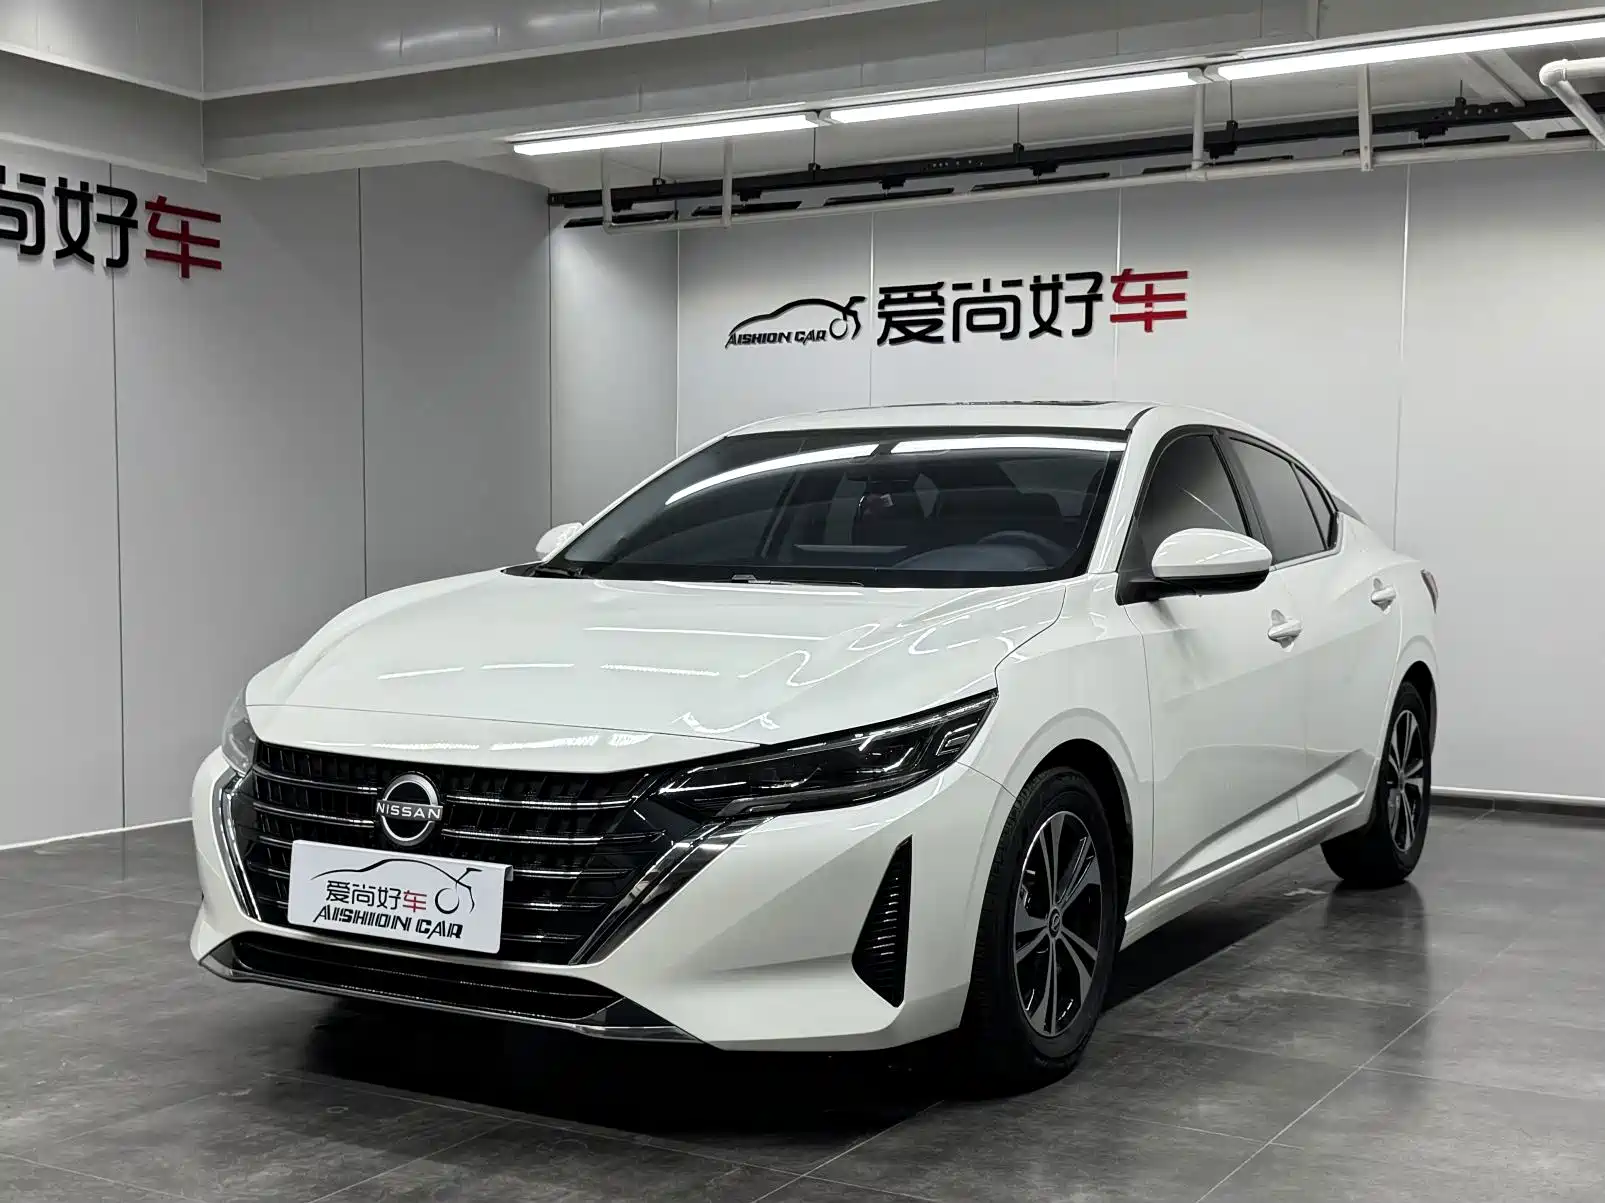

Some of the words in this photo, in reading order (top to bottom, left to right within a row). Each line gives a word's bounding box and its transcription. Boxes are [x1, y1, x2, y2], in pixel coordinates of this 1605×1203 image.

[877, 268, 1188, 345] 爱尚好车
[725, 331, 792, 349] AISHION
[794, 329, 827, 345] CAR
[376, 802, 441, 819] NISSAN
[326, 880, 427, 912] 爱尚好车
[313, 904, 411, 932] AISHION
[415, 918, 463, 939] CAR
